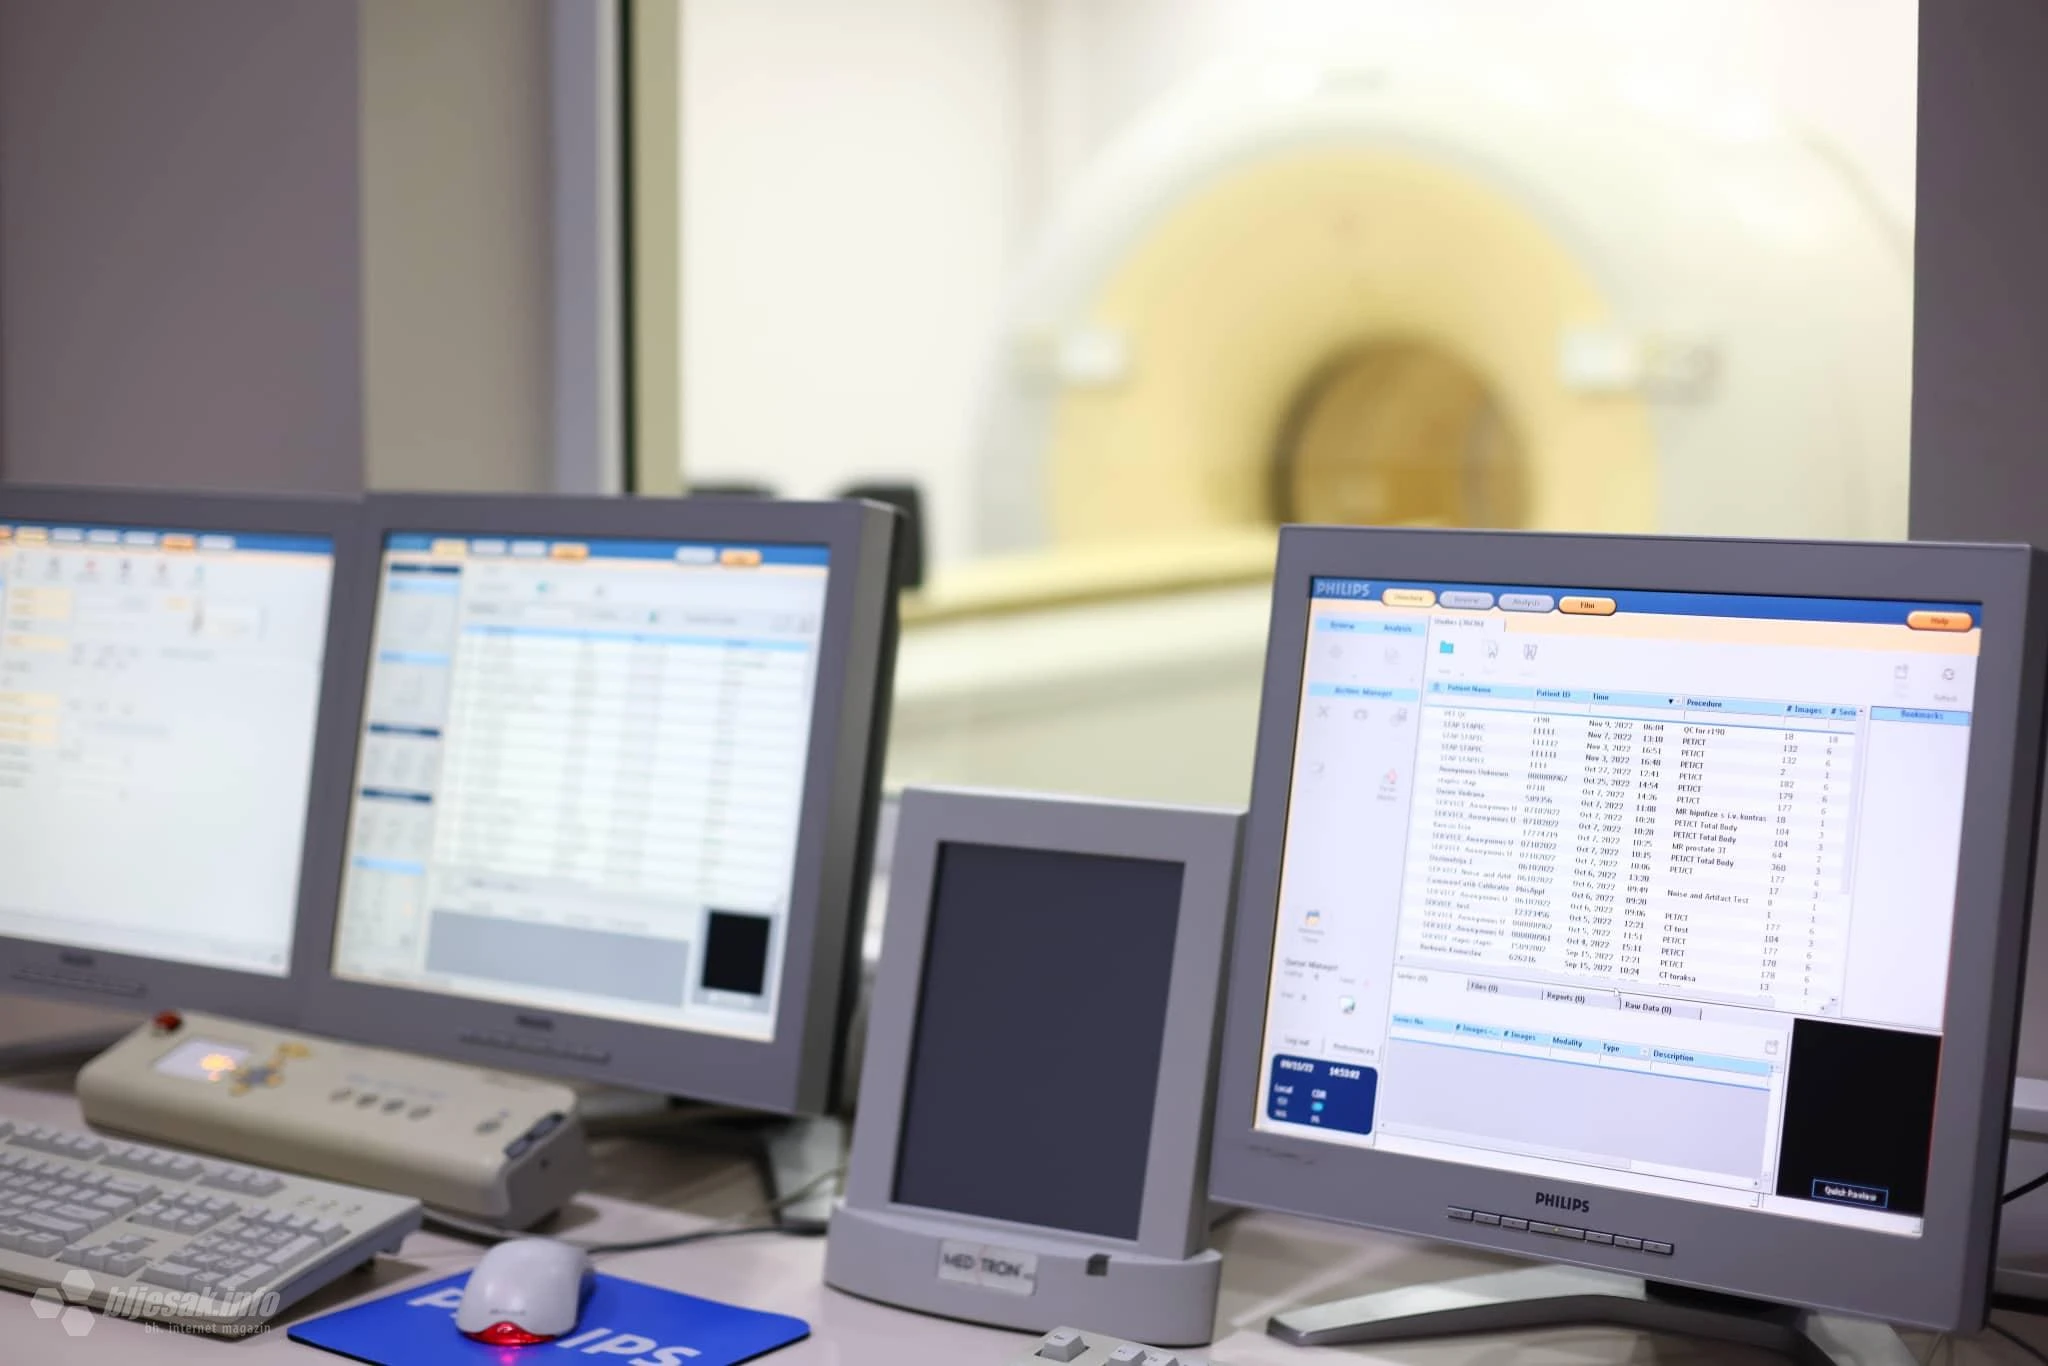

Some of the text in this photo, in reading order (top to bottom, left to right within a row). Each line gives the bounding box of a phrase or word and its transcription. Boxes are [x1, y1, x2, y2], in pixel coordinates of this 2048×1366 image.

[1316, 581, 1371, 596] PHILIPS
[1579, 601, 1595, 609] Film
[1929, 617, 1949, 626] Help
[1446, 683, 1492, 693] Patient Name
[1535, 688, 1571, 698] Patient ID
[1591, 692, 1609, 701] Time
[1685, 698, 1723, 708] Procedure
[1793, 704, 1823, 716] Images
[1588, 719, 1602, 727] Nov
[1614, 720, 1633, 729] 2022
[1587, 730, 1601, 739] Nov
[1613, 732, 1632, 741] 2022
[1681, 737, 1706, 746] PET/CT
[1586, 742, 1600, 750] Nov
[1612, 743, 1631, 752] 2022
[1680, 748, 1705, 758] PET/CT
[1585, 753, 1599, 762] Nov
[1610, 755, 1630, 764] 2022
[1679, 760, 1704, 770] PET/CT
[1584, 765, 1702, 781] Oct 2022 12:41 PET/CT
[1583, 776, 1595, 785] Oct
[1610, 778, 1630, 787] 2022
[1637, 780, 1659, 790] 14:54
[1677, 783, 1701, 793] PET/CT
[1581, 787, 1594, 796] Oct
[1605, 789, 1625, 799] 2022
[1676, 795, 1700, 805] PET/CT
[1580, 799, 1593, 808] Oct
[1603, 801, 1624, 810] 2022
[1579, 810, 1592, 819] Oct
[1602, 812, 1622, 822] 2022
[1673, 818, 1698, 828] PET/CT
[1699, 820, 1718, 830] Total
[1719, 822, 1738, 833] Body
[1578, 822, 1591, 831] Oct
[1601, 824, 1621, 833] 2022
[1672, 830, 1697, 840] PET/CT
[1698, 832, 1717, 842] Total
[1717, 834, 1737, 845] Body
[1576, 833, 1590, 842] Oct
[1600, 835, 1620, 845] 2022
[1685, 843, 1712, 854] prostate
[1575, 845, 1588, 854] Oct
[1599, 847, 1619, 856] 2022
[1670, 853, 1695, 863] PET/CT
[1696, 856, 1715, 865] Total
[1715, 857, 1734, 868] Body
[1574, 856, 1587, 865] Oct
[1598, 858, 1618, 868] 2022
[1669, 865, 1693, 875] PET/CT
[1573, 868, 1586, 877] Oct
[1597, 870, 1617, 880] 2022
[1571, 891, 1614, 903] Oct 2022
[1572, 879, 1585, 888] Oct
[1596, 881, 1616, 891] 2022
[1667, 888, 1687, 898] Noise
[1688, 890, 1703, 900] and
[1732, 895, 1749, 904] Test
[1570, 902, 1583, 911] Oct
[1593, 905, 1613, 914] 2022
[1664, 912, 1689, 922] PET/CT
[1568, 914, 1582, 923] Oct
[1592, 916, 1612, 926] 2022
[1567, 925, 1580, 934] Oct
[1591, 928, 1611, 937] 2022
[1662, 935, 1687, 946] PET/CT
[1566, 937, 1579, 946] Oct
[1590, 939, 1610, 949] 2022
[1661, 947, 1685, 957] PET/CT
[1594, 951, 1613, 961] 2022
[1660, 959, 1684, 969] PET/CT
[1592, 963, 1612, 973] 2022
[1470, 981, 1487, 991] Files
[1546, 991, 1573, 1002] Reports
[1624, 1001, 1641, 1010] Raw
[1642, 1003, 1660, 1012] Data
[1462, 1024, 1488, 1035] Images
[1510, 1030, 1536, 1042] Images
[1551, 1036, 1583, 1048] Modality
[1602, 1042, 1620, 1053] Type
[1652, 1049, 1694, 1063] Description
[1534, 1191, 1591, 1214] PHILIPS
[406, 1288, 702, 1366] PIPS
